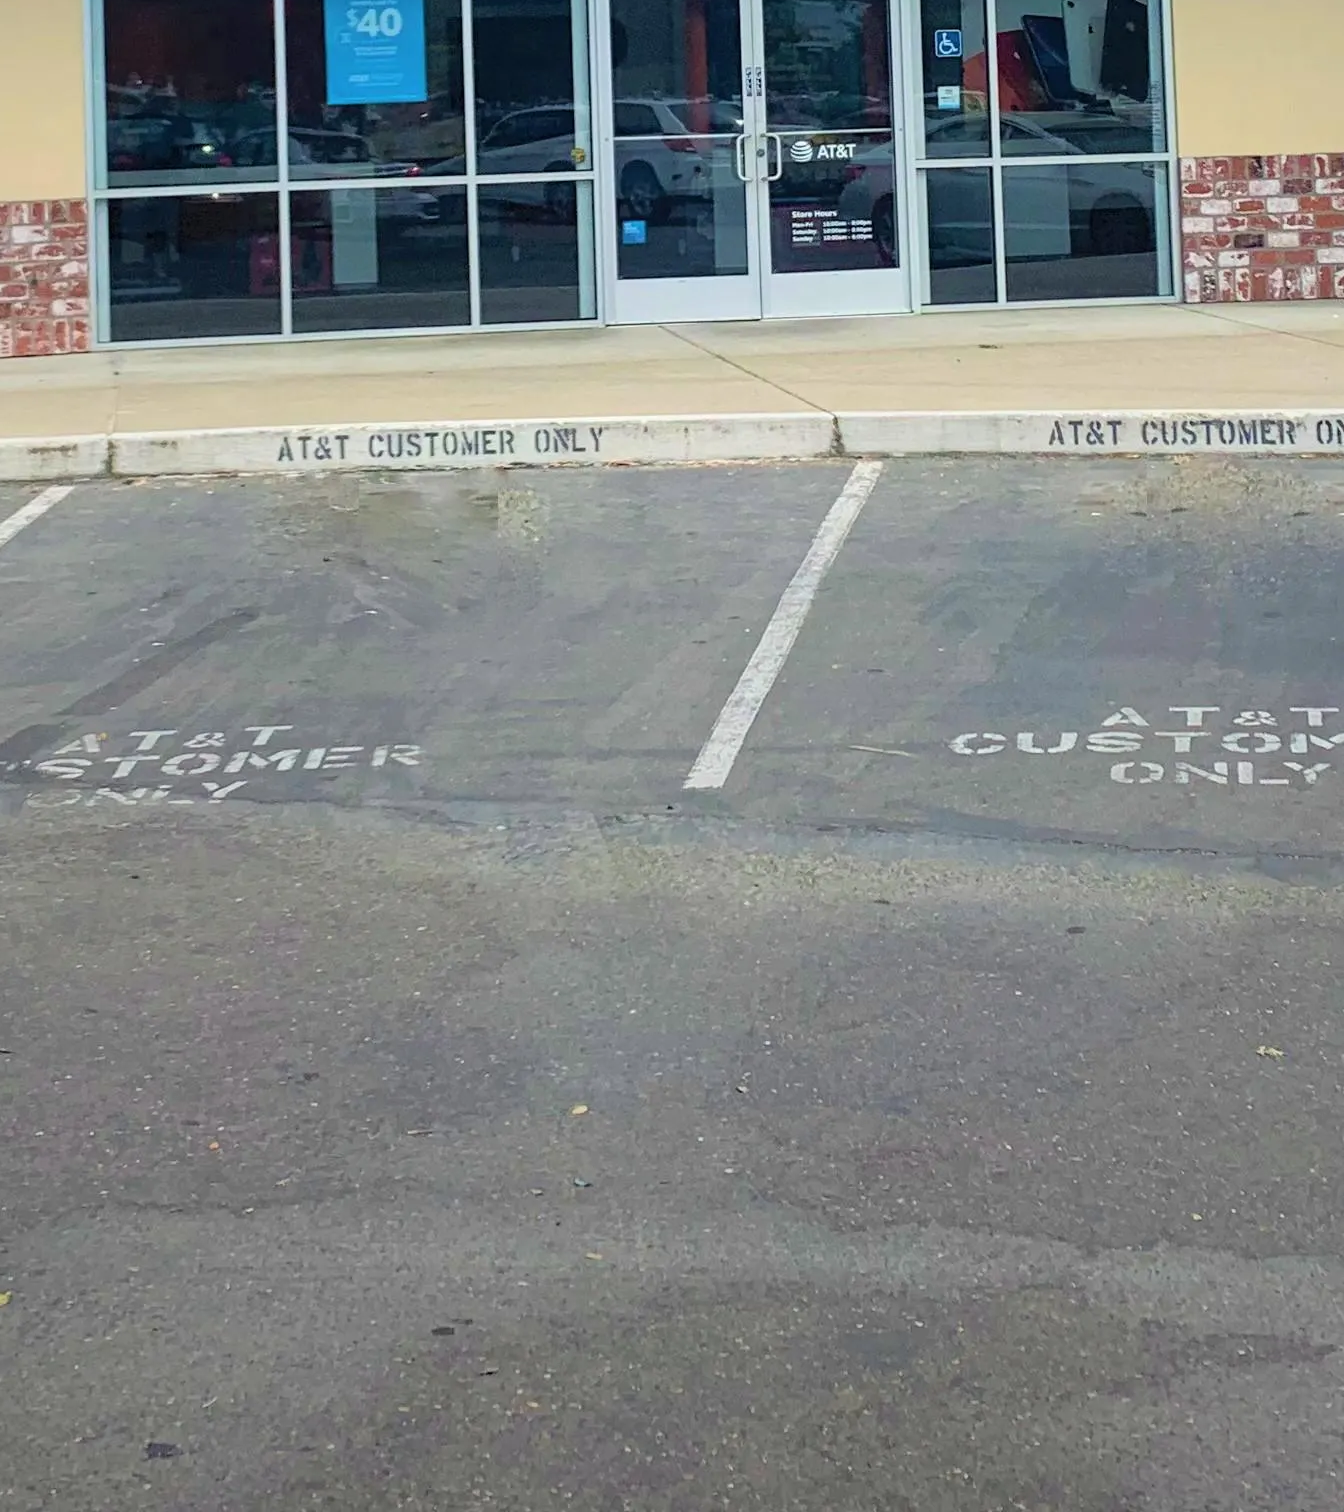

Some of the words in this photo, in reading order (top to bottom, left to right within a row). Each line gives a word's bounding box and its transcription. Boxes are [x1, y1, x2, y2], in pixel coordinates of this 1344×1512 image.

[345, 7, 404, 38] $40
[816, 143, 857, 160] AT&T
[791, 210, 813, 219] Store
[814, 209, 838, 218] Hours
[277, 435, 351, 462] AT&T
[368, 429, 515, 459] CUSTOMER
[534, 426, 605, 455] ONLY
[1048, 419, 1123, 446] AT&T
[1141, 419, 1297, 446] CUSTOMER
[1101, 706, 1340, 728] AT&T
[54, 724, 293, 755] AT&T
[1109, 760, 1332, 785] ONLY
[26, 780, 247, 809] ONLY
